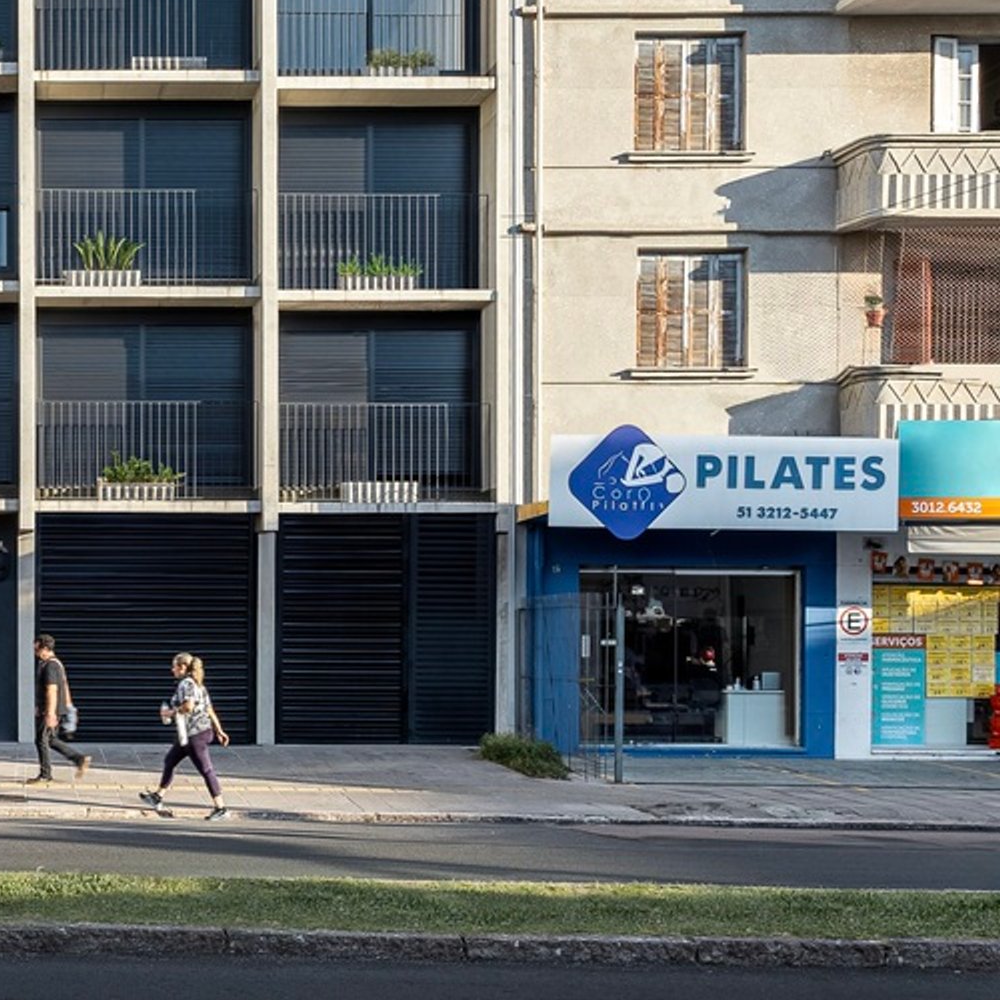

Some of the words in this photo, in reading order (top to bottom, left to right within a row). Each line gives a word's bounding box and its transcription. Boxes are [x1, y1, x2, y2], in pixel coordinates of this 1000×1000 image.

[696, 455, 886, 491] PILATES
[736, 506, 751, 519] 51
[756, 507, 838, 519] 3212-5447
[848, 612, 861, 630] E
